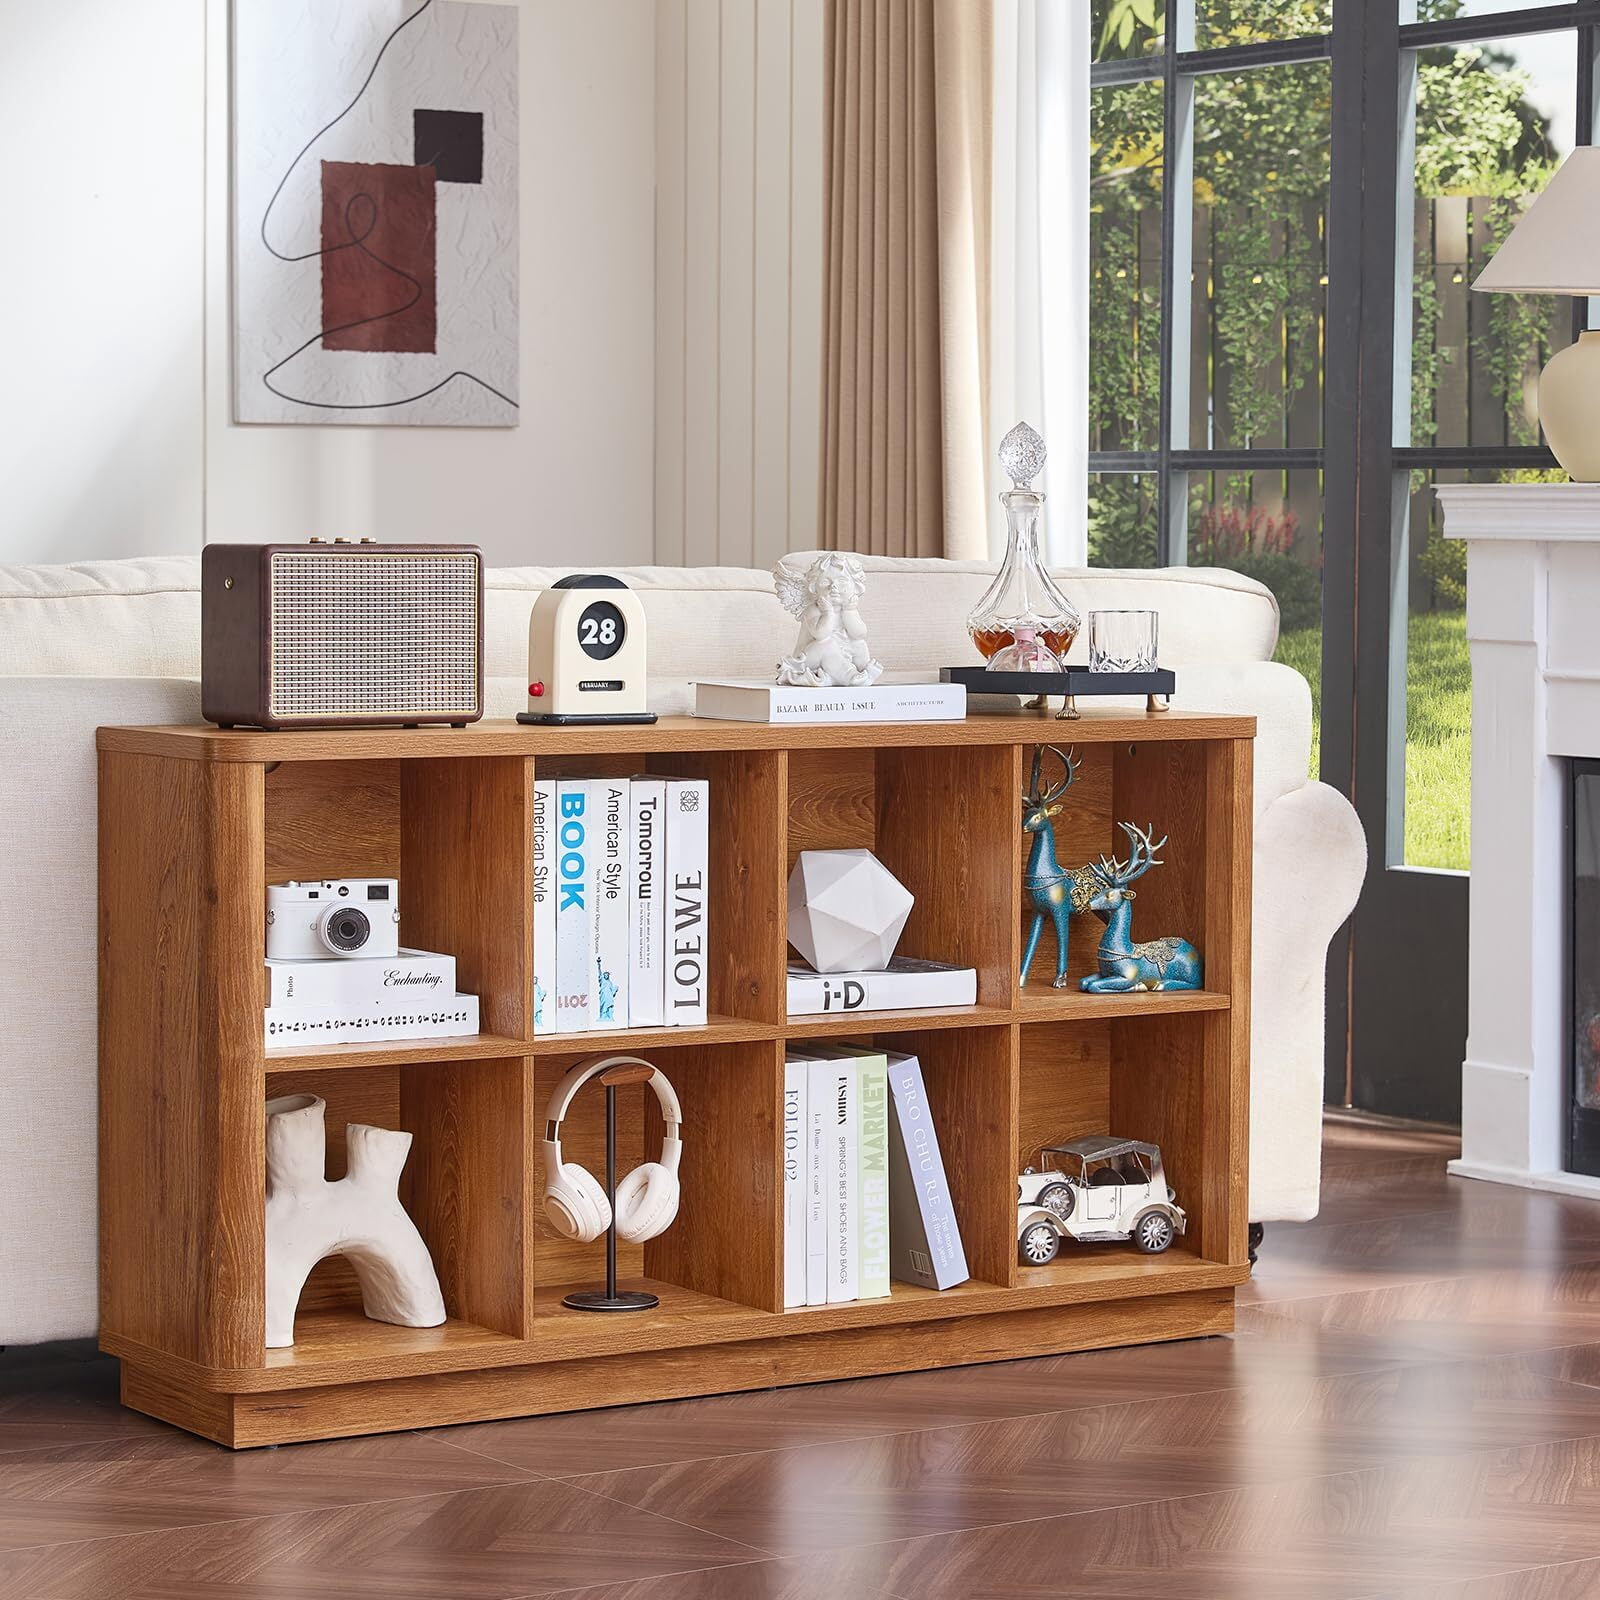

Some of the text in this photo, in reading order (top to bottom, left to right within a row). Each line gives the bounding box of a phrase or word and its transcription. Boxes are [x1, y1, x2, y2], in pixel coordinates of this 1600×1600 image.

[580, 618, 616, 645] 28
[776, 704, 808, 714] BAZAAR
[534, 790, 549, 903] American Style
[560, 792, 586, 912] BOOK
[602, 788, 623, 900] American Style
[638, 797, 657, 899] Tomorrow
[674, 870, 702, 1009] LOEWE
[558, 994, 588, 1009] 2011
[823, 981, 865, 1011] i-D
[785, 1089, 799, 1182] FOLIO-02
[837, 1076, 848, 1284] FASHION SPRING'S BEST SHOES AND BAGS
[863, 1073, 886, 1279] FLOWER MARKET
[902, 1077, 941, 1206] BRO CHU RE
